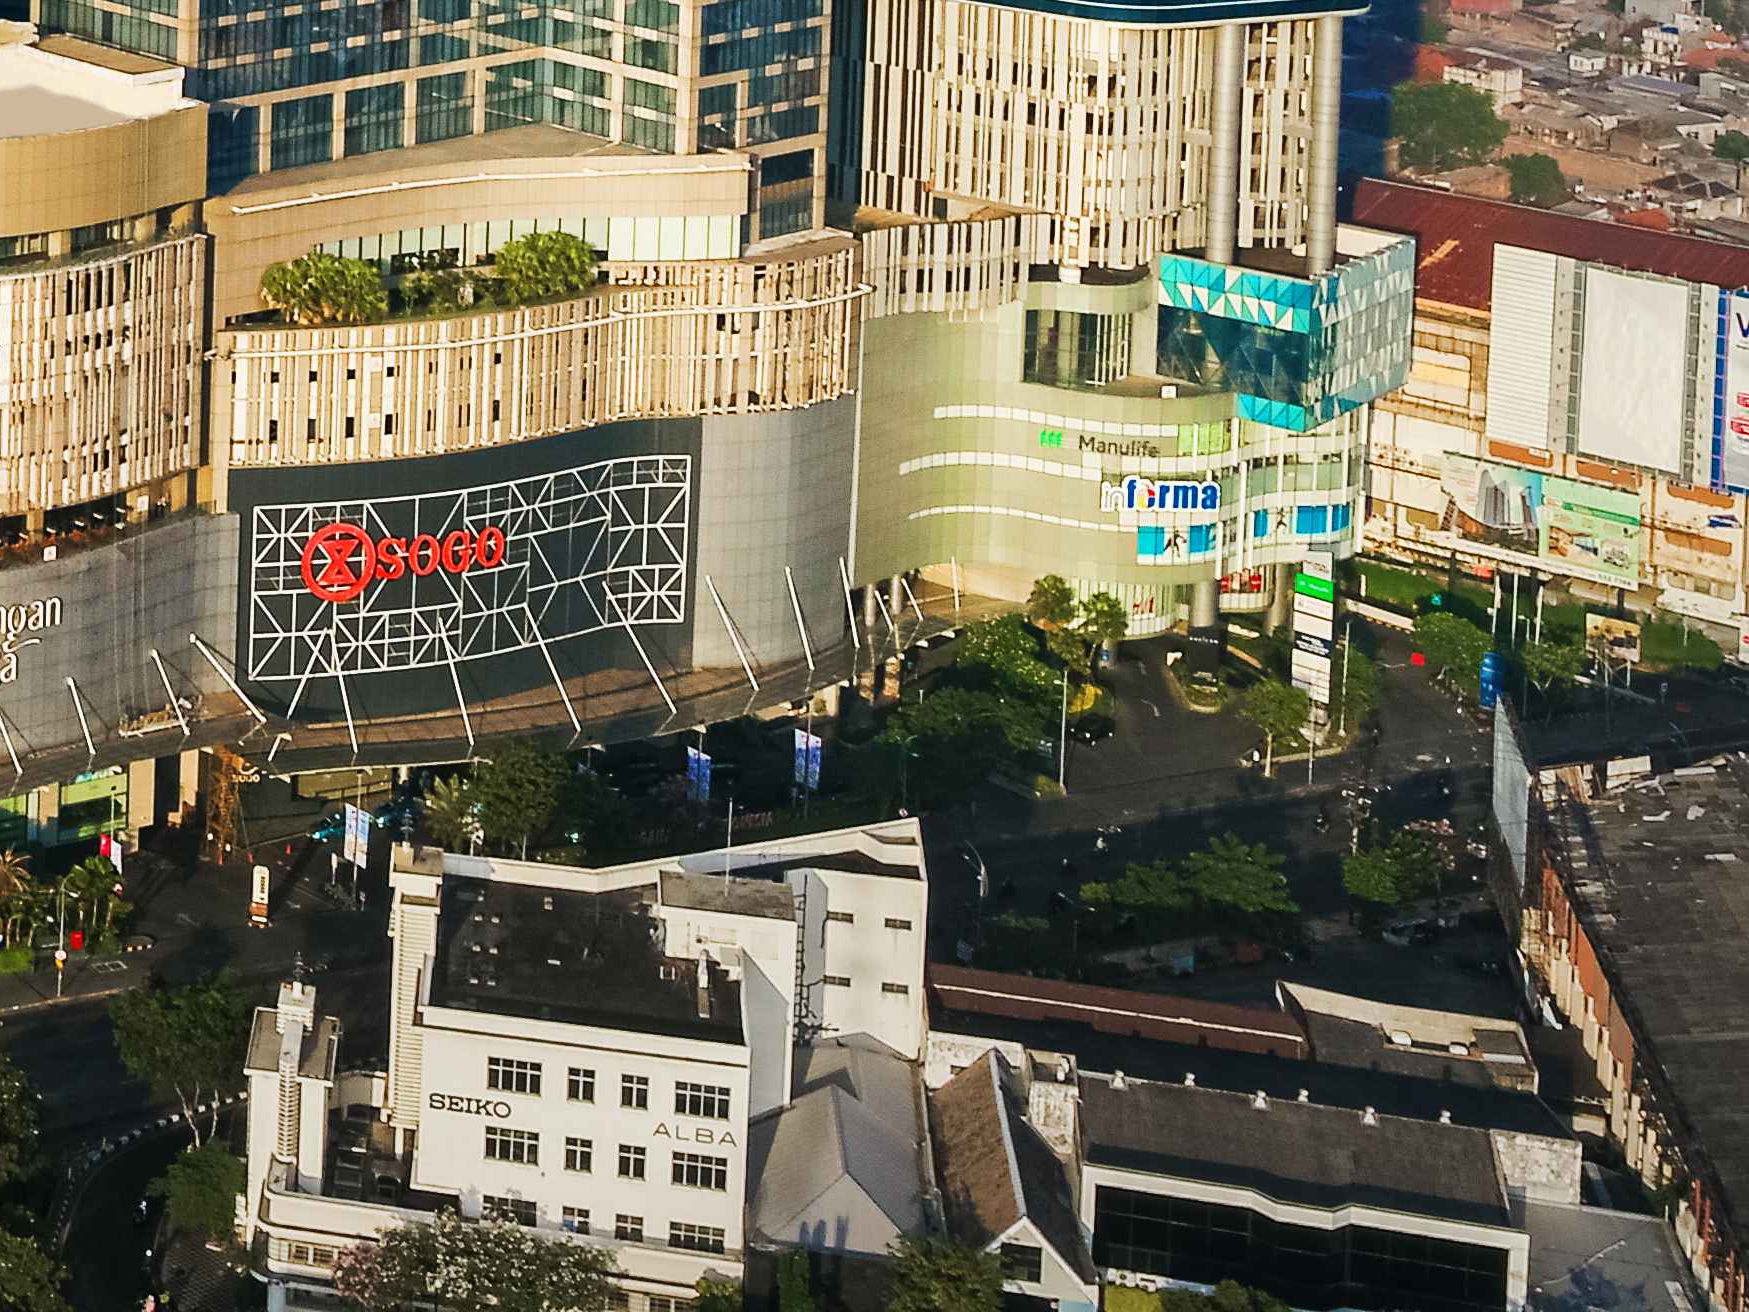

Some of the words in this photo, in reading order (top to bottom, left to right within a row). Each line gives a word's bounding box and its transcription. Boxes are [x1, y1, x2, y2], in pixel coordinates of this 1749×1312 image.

[1078, 434, 1161, 458] Manulife
[1103, 478, 1220, 511] informa
[375, 526, 506, 580] SOGO
[429, 1092, 512, 1119] SEIKO
[652, 1122, 738, 1148] ALBA
